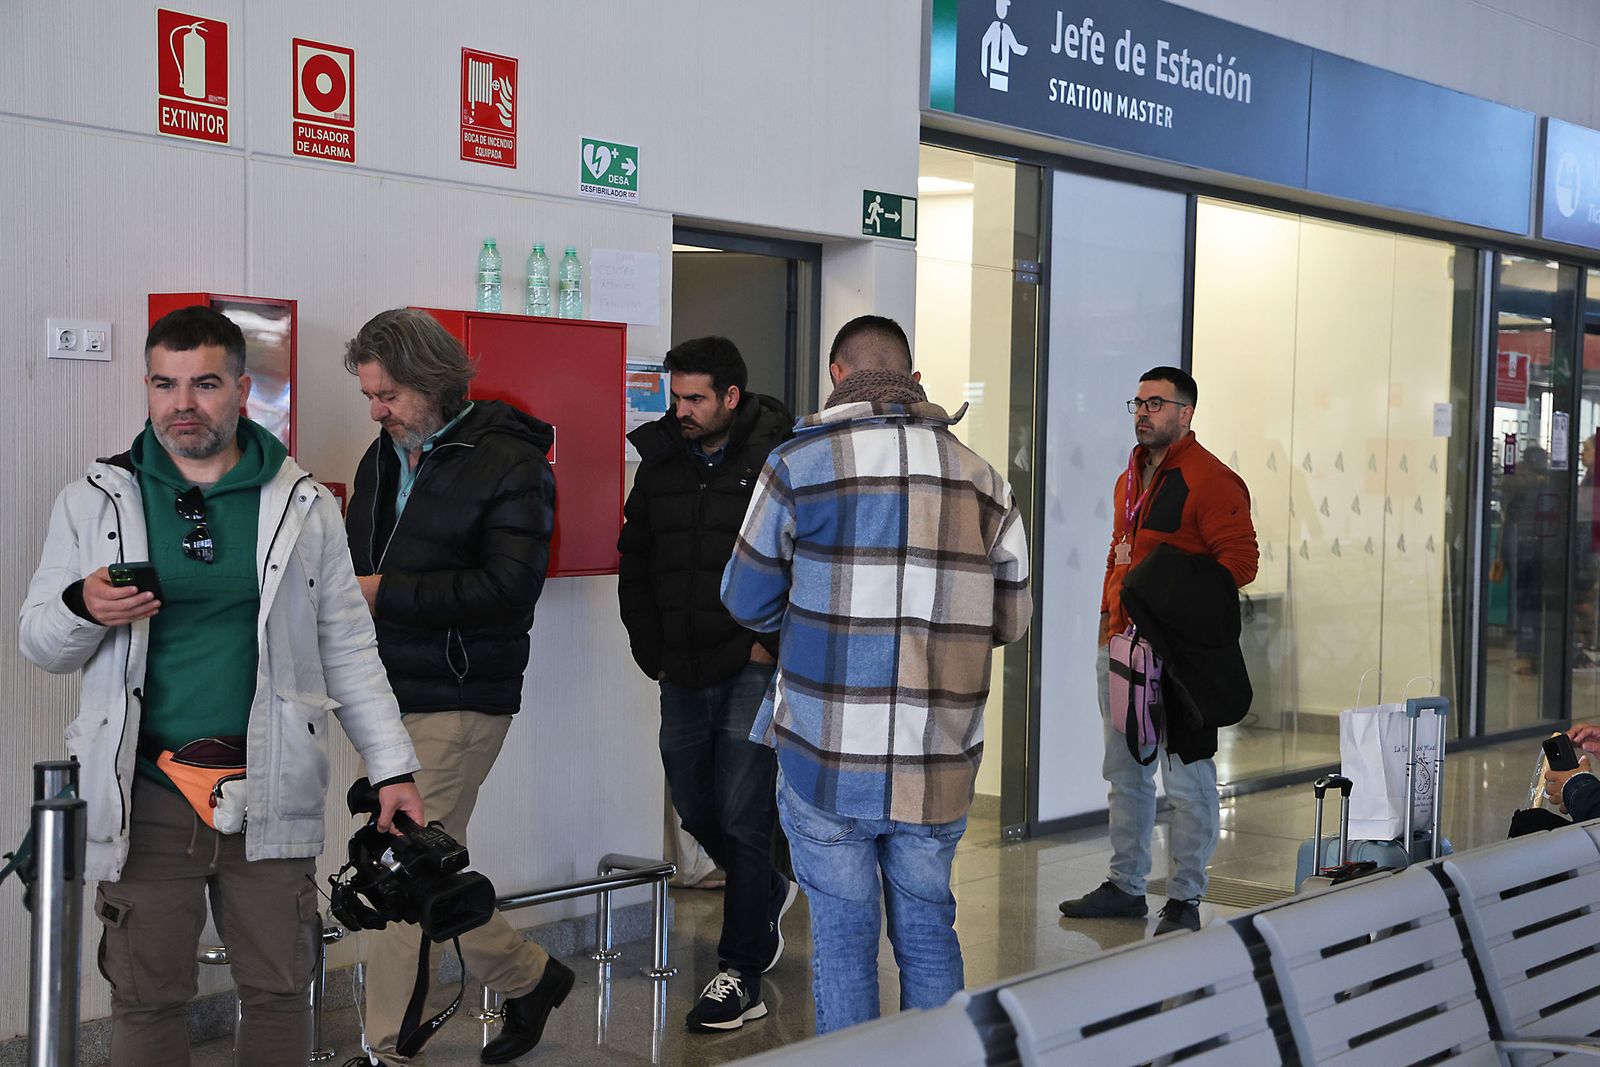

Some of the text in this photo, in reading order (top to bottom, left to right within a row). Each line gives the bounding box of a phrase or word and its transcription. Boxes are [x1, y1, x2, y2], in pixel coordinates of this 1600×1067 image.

[1050, 10, 1251, 104] Jefe de Estación
[1049, 77, 1173, 129] STATION MASTER
[162, 106, 225, 135] EXTINTOR
[298, 126, 349, 144] PULSADOR
[463, 132, 514, 150] BOCA DE INCENDIO
[297, 141, 351, 159] DE ALARMA
[475, 147, 503, 160] EQUIPADA
[608, 174, 630, 186] DESA
[580, 184, 627, 198] DESFIBRILADOR
